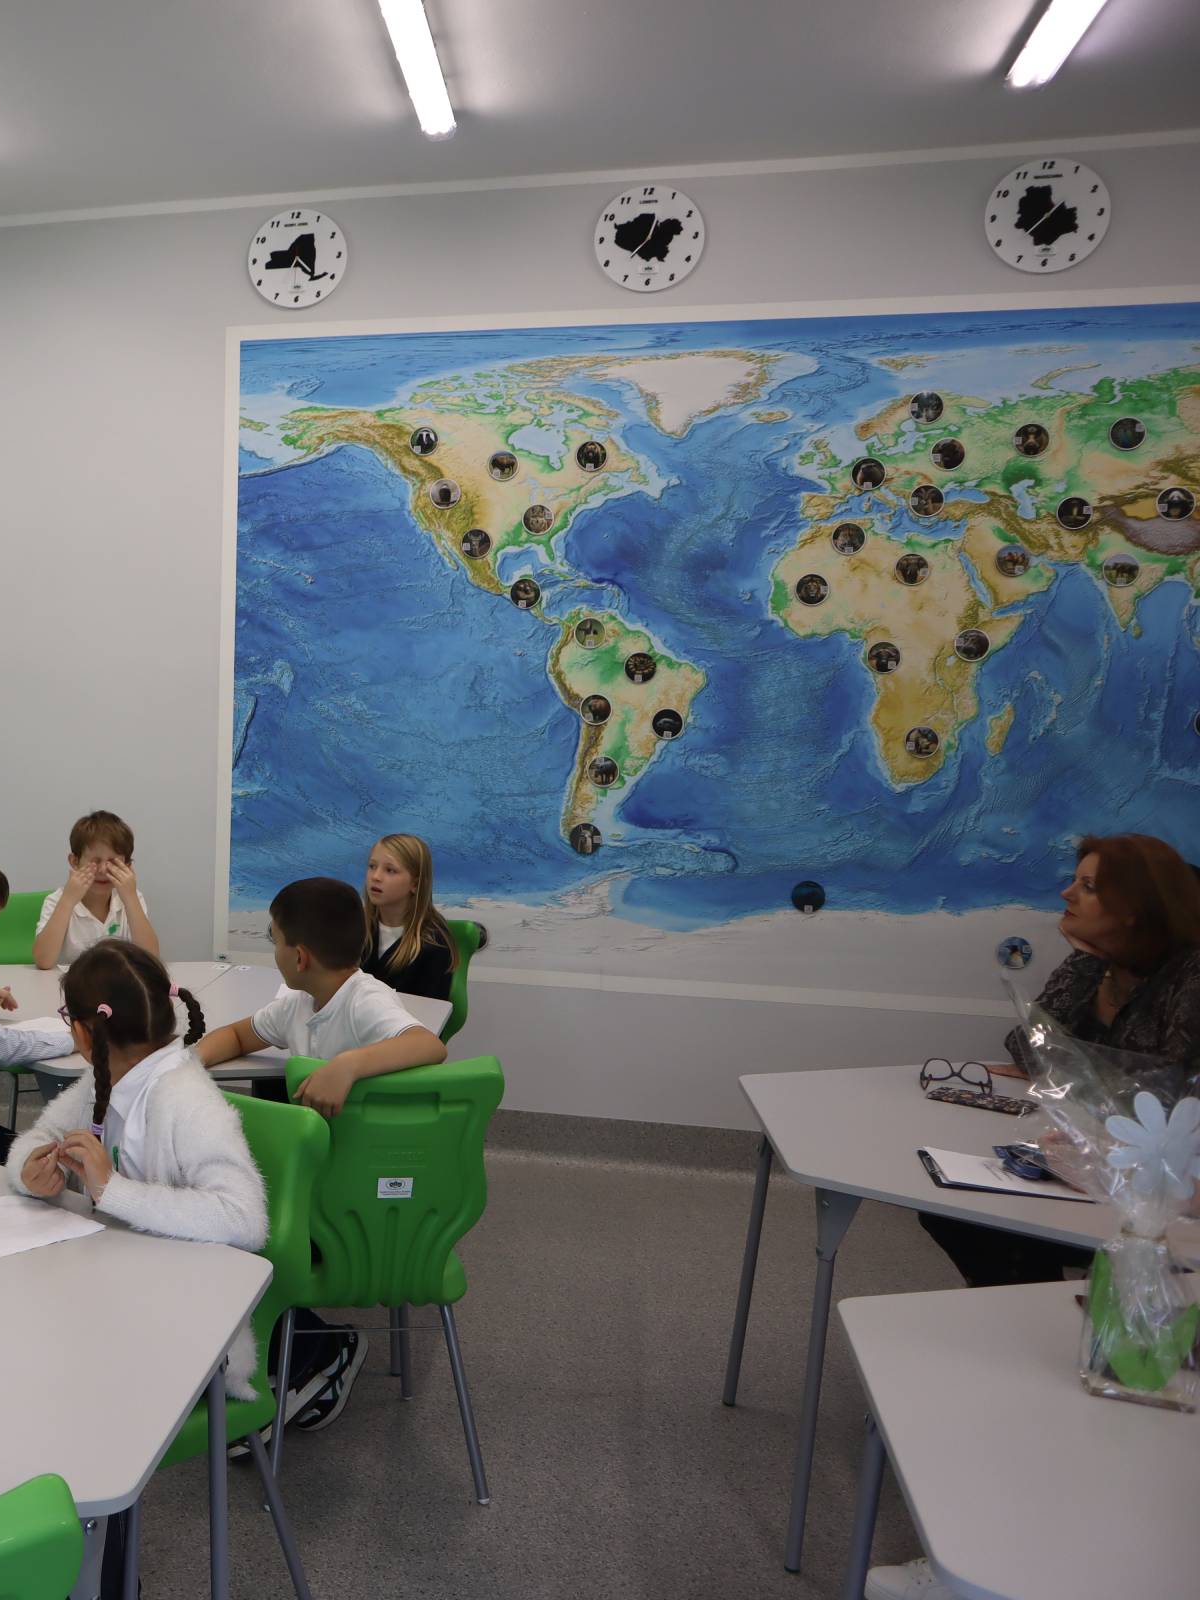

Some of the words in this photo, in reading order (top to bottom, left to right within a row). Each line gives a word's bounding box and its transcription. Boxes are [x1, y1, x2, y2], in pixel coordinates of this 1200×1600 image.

[1042, 160, 1056, 170] 12
[1074, 166, 1080, 174] 1
[1016, 172, 1028, 180] 11
[644, 188, 654, 196] 12
[1090, 184, 1098, 194] 2
[672, 192, 676, 200] 1
[996, 190, 1010, 198] 10
[620, 196, 632, 204] 11
[292, 212, 302, 220] 12
[686, 210, 694, 218] 2
[1096, 208, 1104, 216] 3
[604, 214, 616, 222] 10
[990, 214, 996, 222] 9
[256, 236, 266, 244] 10
[330, 232, 336, 240] 2
[598, 236, 604, 244] 9
[692, 232, 700, 240] 3
[1088, 234, 1096, 242] 4
[994, 240, 1002, 248] 8
[252, 258, 258, 266] 9
[1016, 254, 1024, 264] 7
[1040, 258, 1048, 266] 6
[1068, 254, 1076, 262] 5
[604, 260, 610, 268] 8
[330, 272, 336, 280] 4
[668, 274, 674, 282] 5
[644, 278, 650, 286] 6
[316, 290, 320, 298] 5
